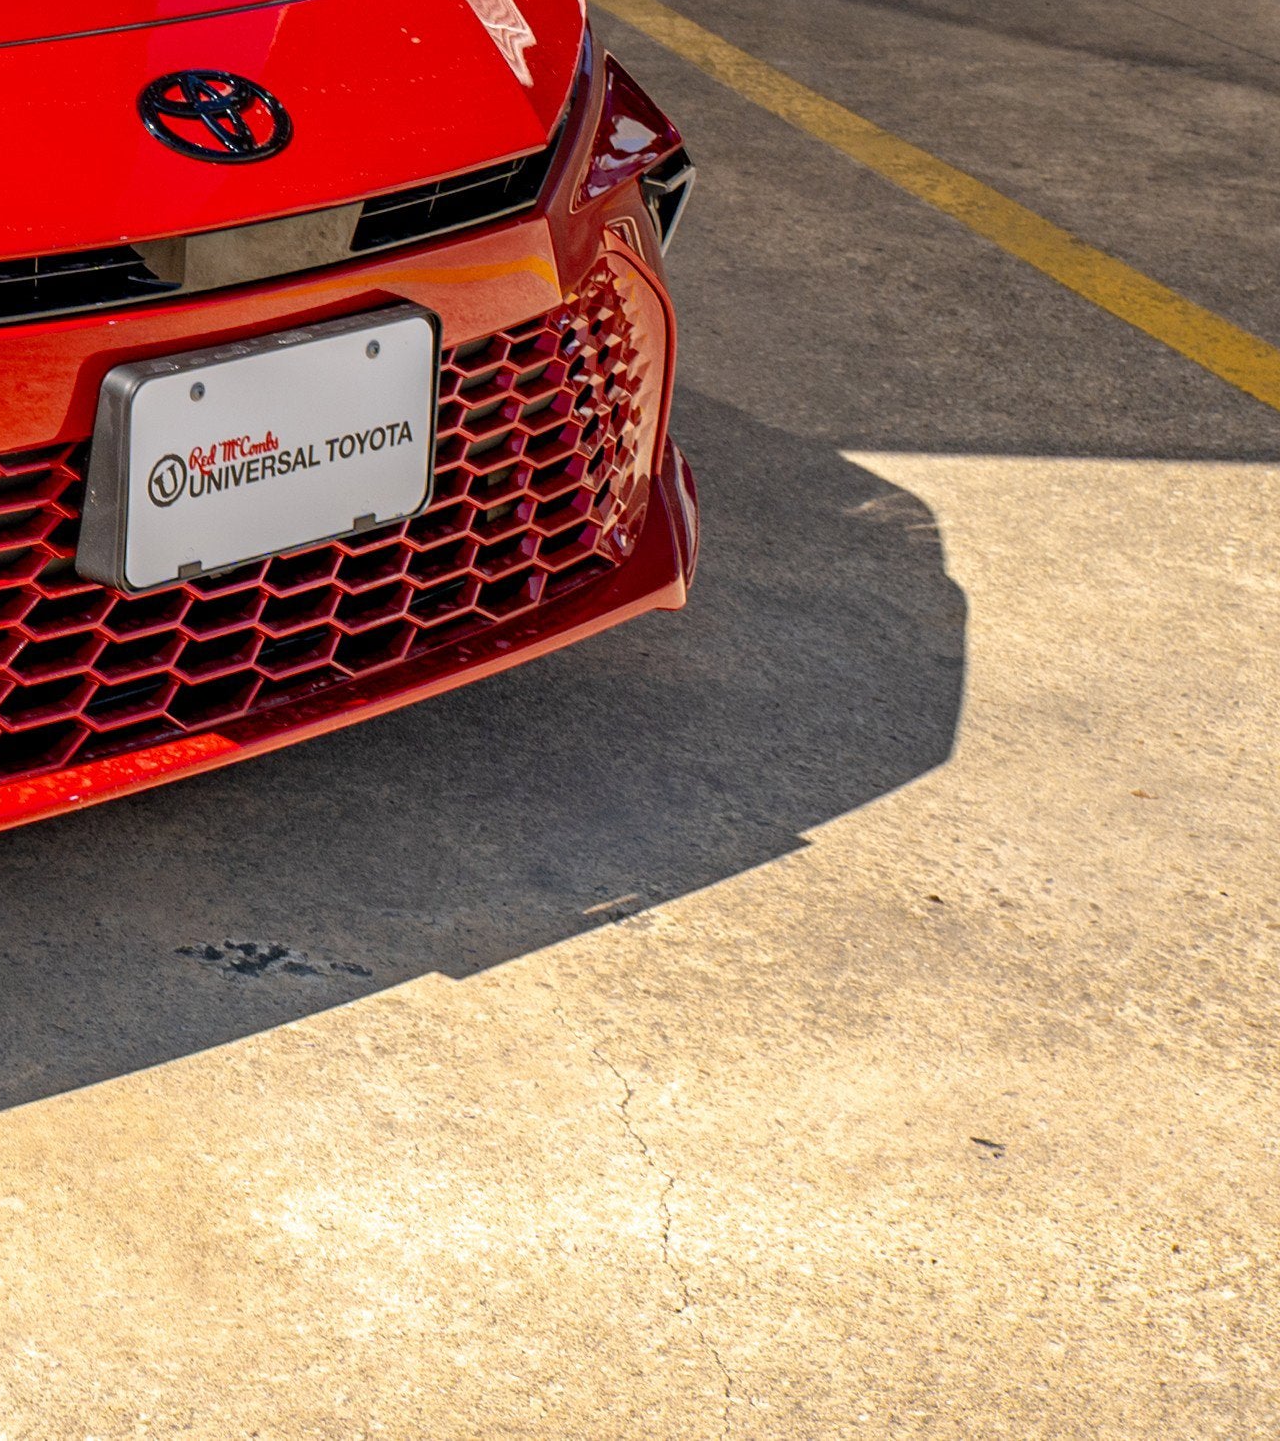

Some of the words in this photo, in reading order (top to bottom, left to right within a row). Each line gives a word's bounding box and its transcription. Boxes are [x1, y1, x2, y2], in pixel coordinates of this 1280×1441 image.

[188, 444, 217, 476] Red
[219, 430, 279, 462] McCombs
[189, 444, 321, 498] UNIVERSAL
[325, 420, 414, 462] TOYOTA
